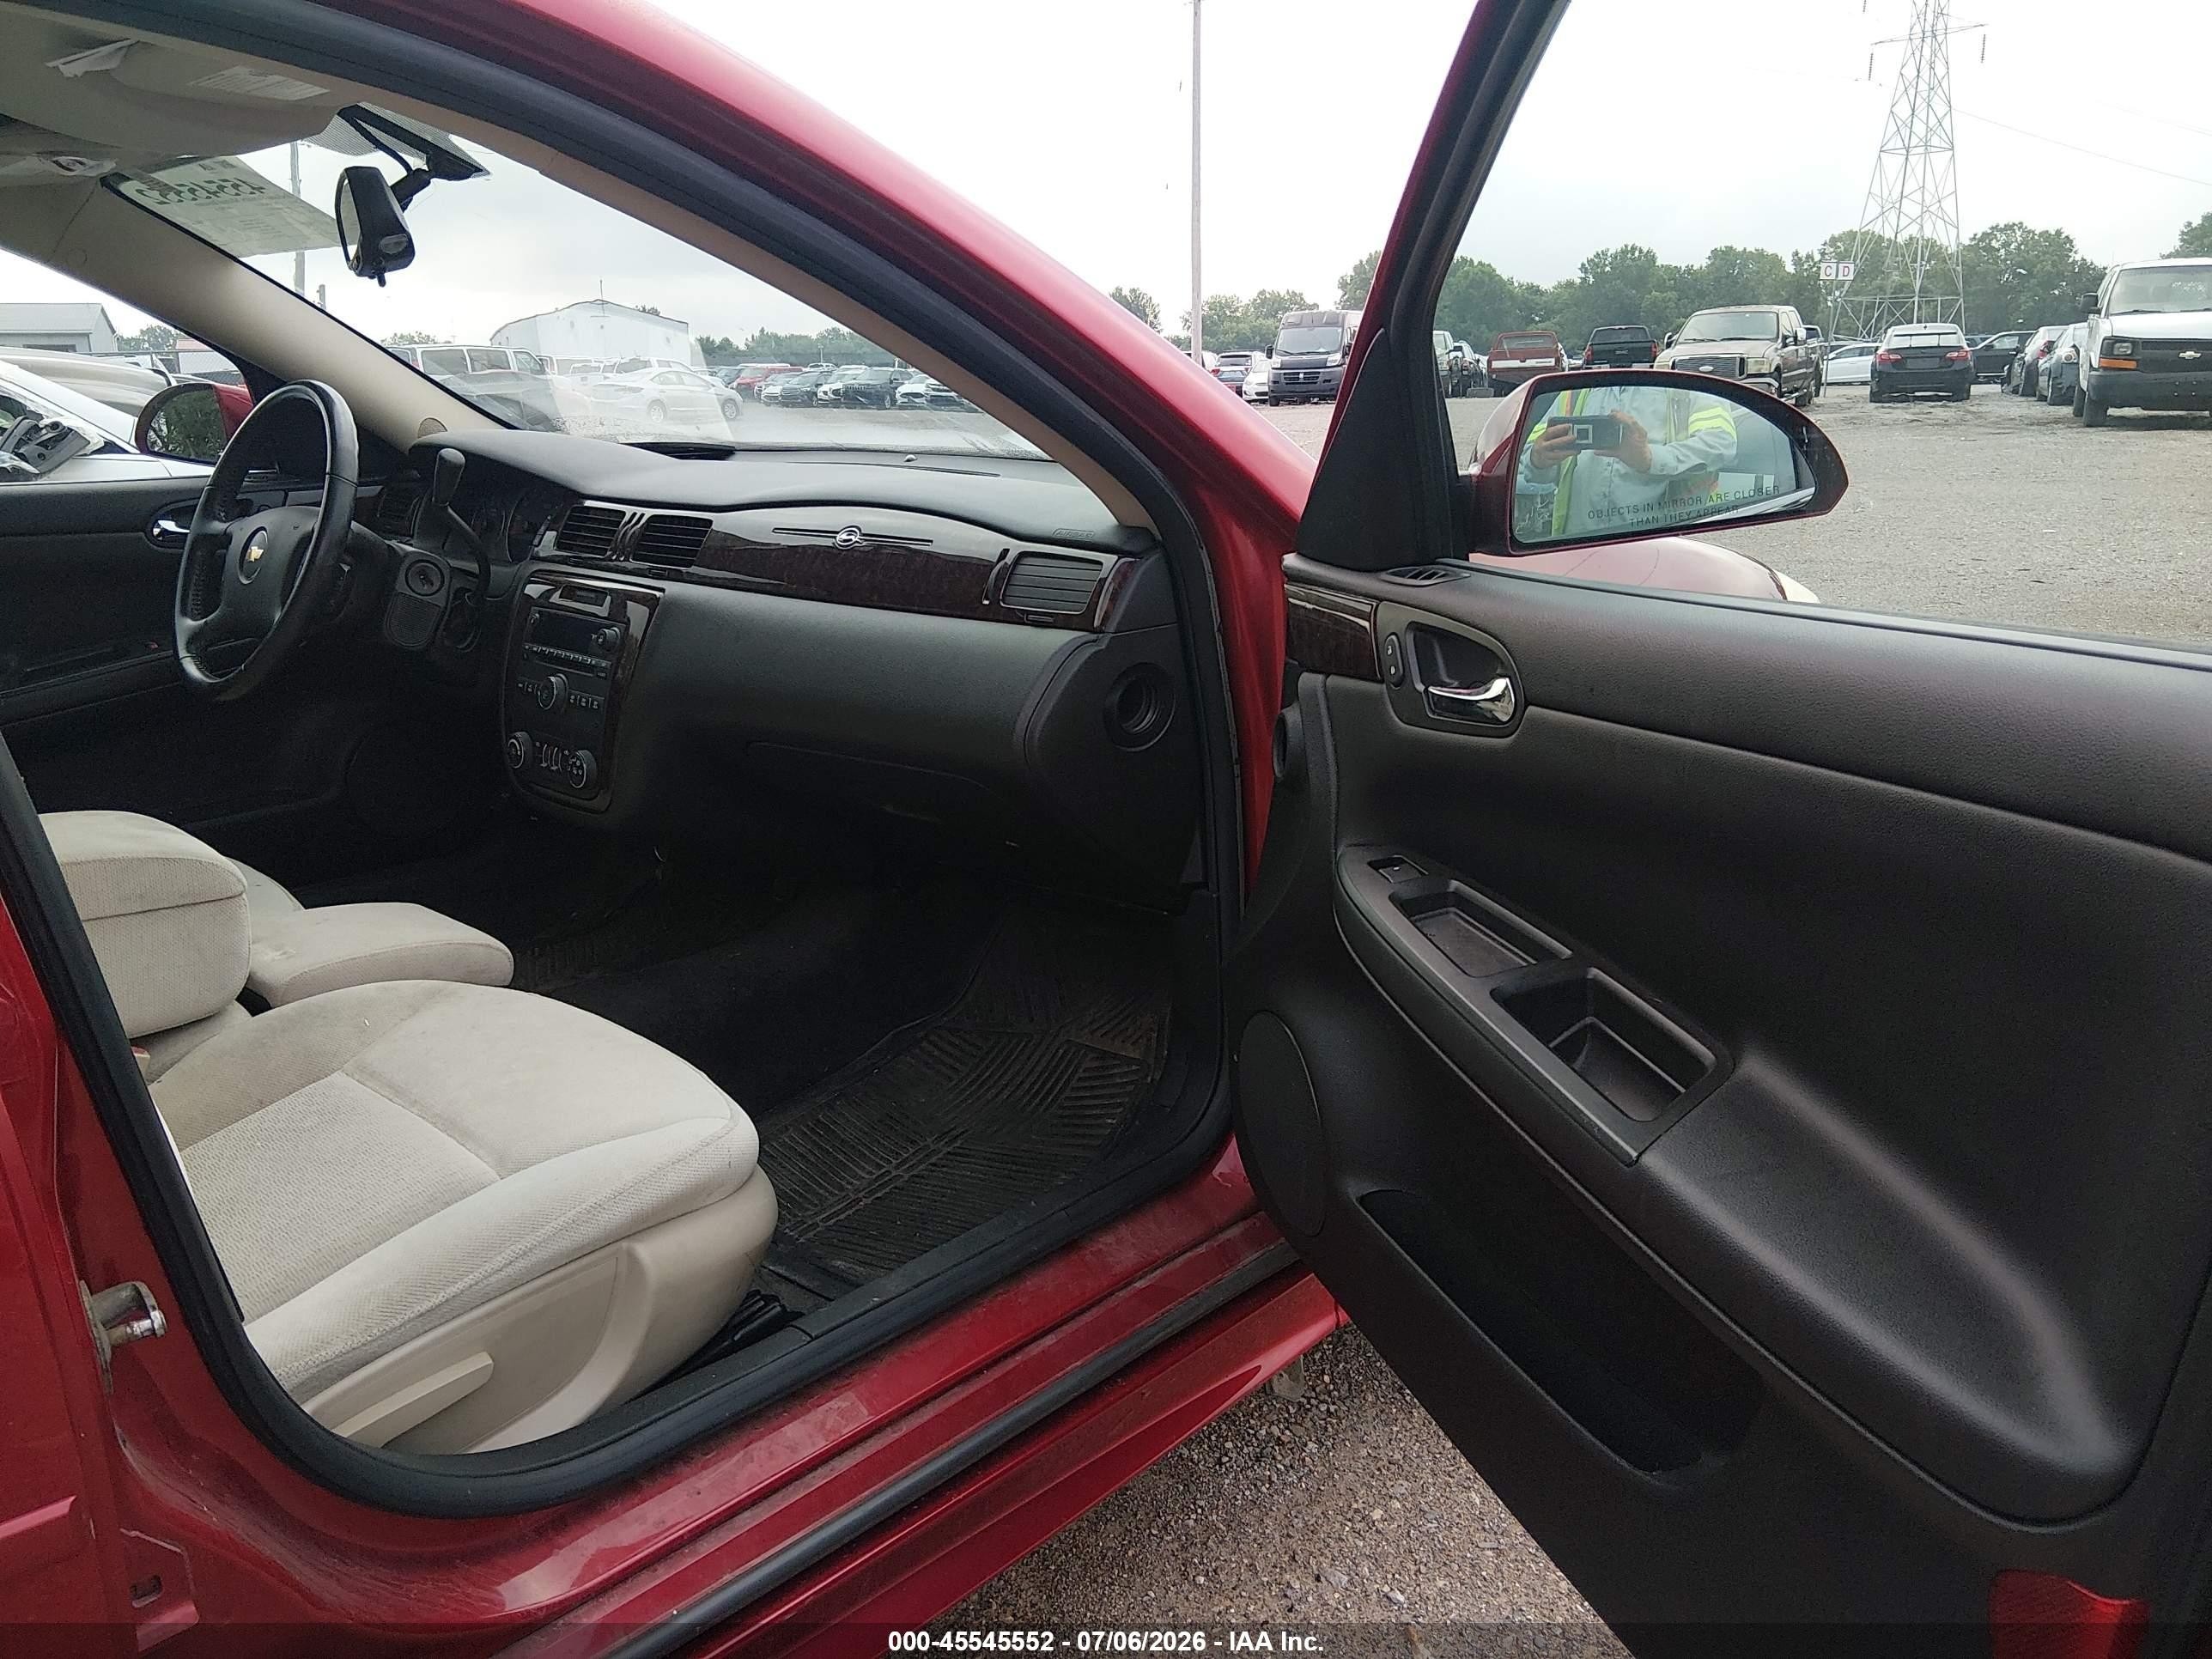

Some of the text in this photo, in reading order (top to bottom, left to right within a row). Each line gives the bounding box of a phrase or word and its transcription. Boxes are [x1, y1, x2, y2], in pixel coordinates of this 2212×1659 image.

[1825, 265, 1832, 277] C
[1843, 265, 1850, 277] D
[1588, 485, 1780, 520] OBJECTS IN MIRROR ARE CLOSER
[1629, 504, 1739, 528] THAN THEY APPEAR
